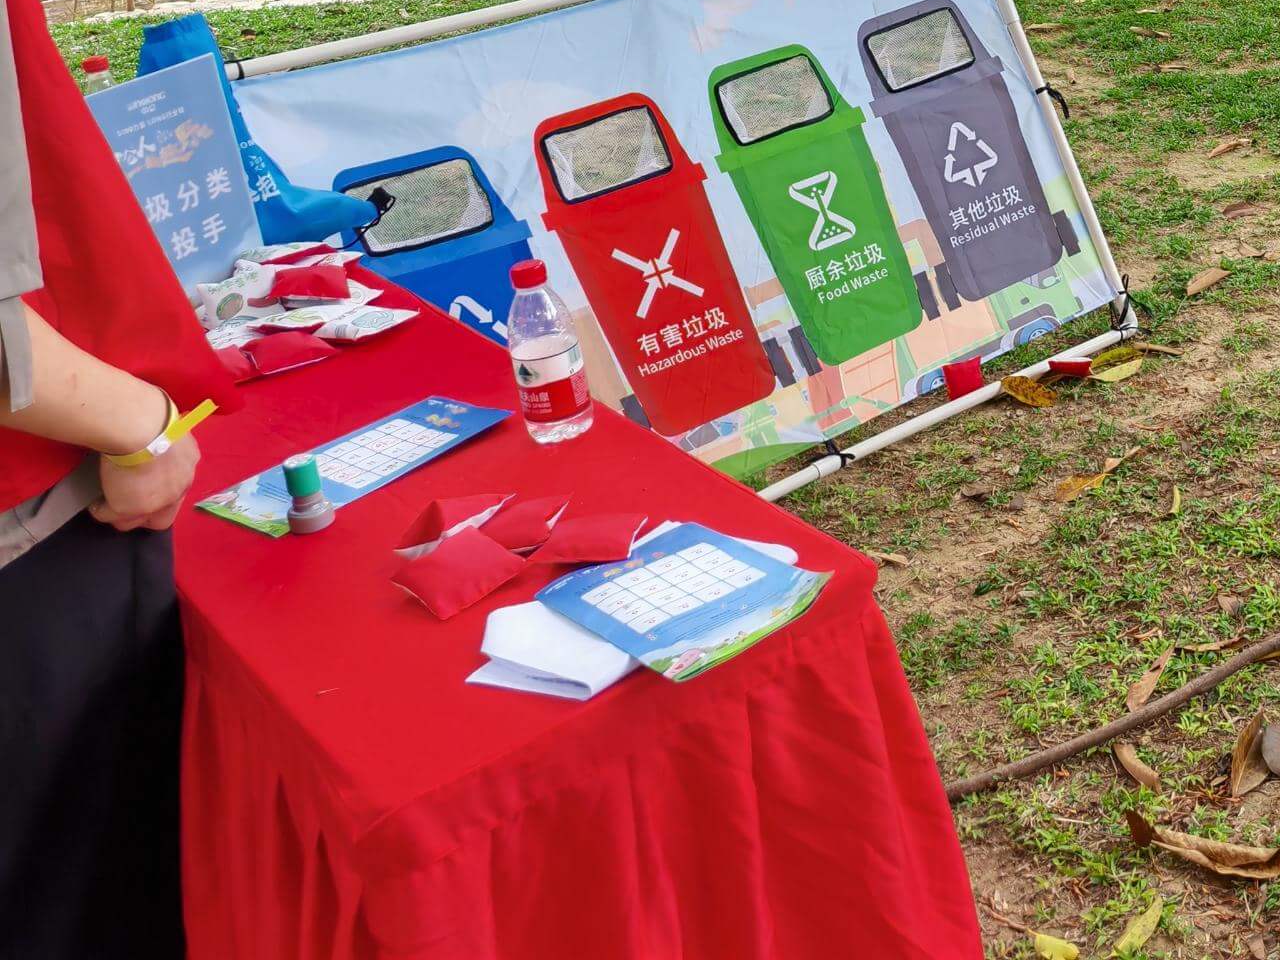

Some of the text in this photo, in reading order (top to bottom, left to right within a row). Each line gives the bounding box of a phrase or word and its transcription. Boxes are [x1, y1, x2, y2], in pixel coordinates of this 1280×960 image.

[948, 185, 1023, 231] 其他垃圾
[949, 204, 1036, 248] Residual Waste
[170, 213, 227, 261] 投手
[804, 243, 887, 290] 厨余垃圾
[817, 268, 889, 304] Food Waste
[637, 306, 729, 357] 有害垃圾
[637, 328, 744, 377] Hazardous Waste
